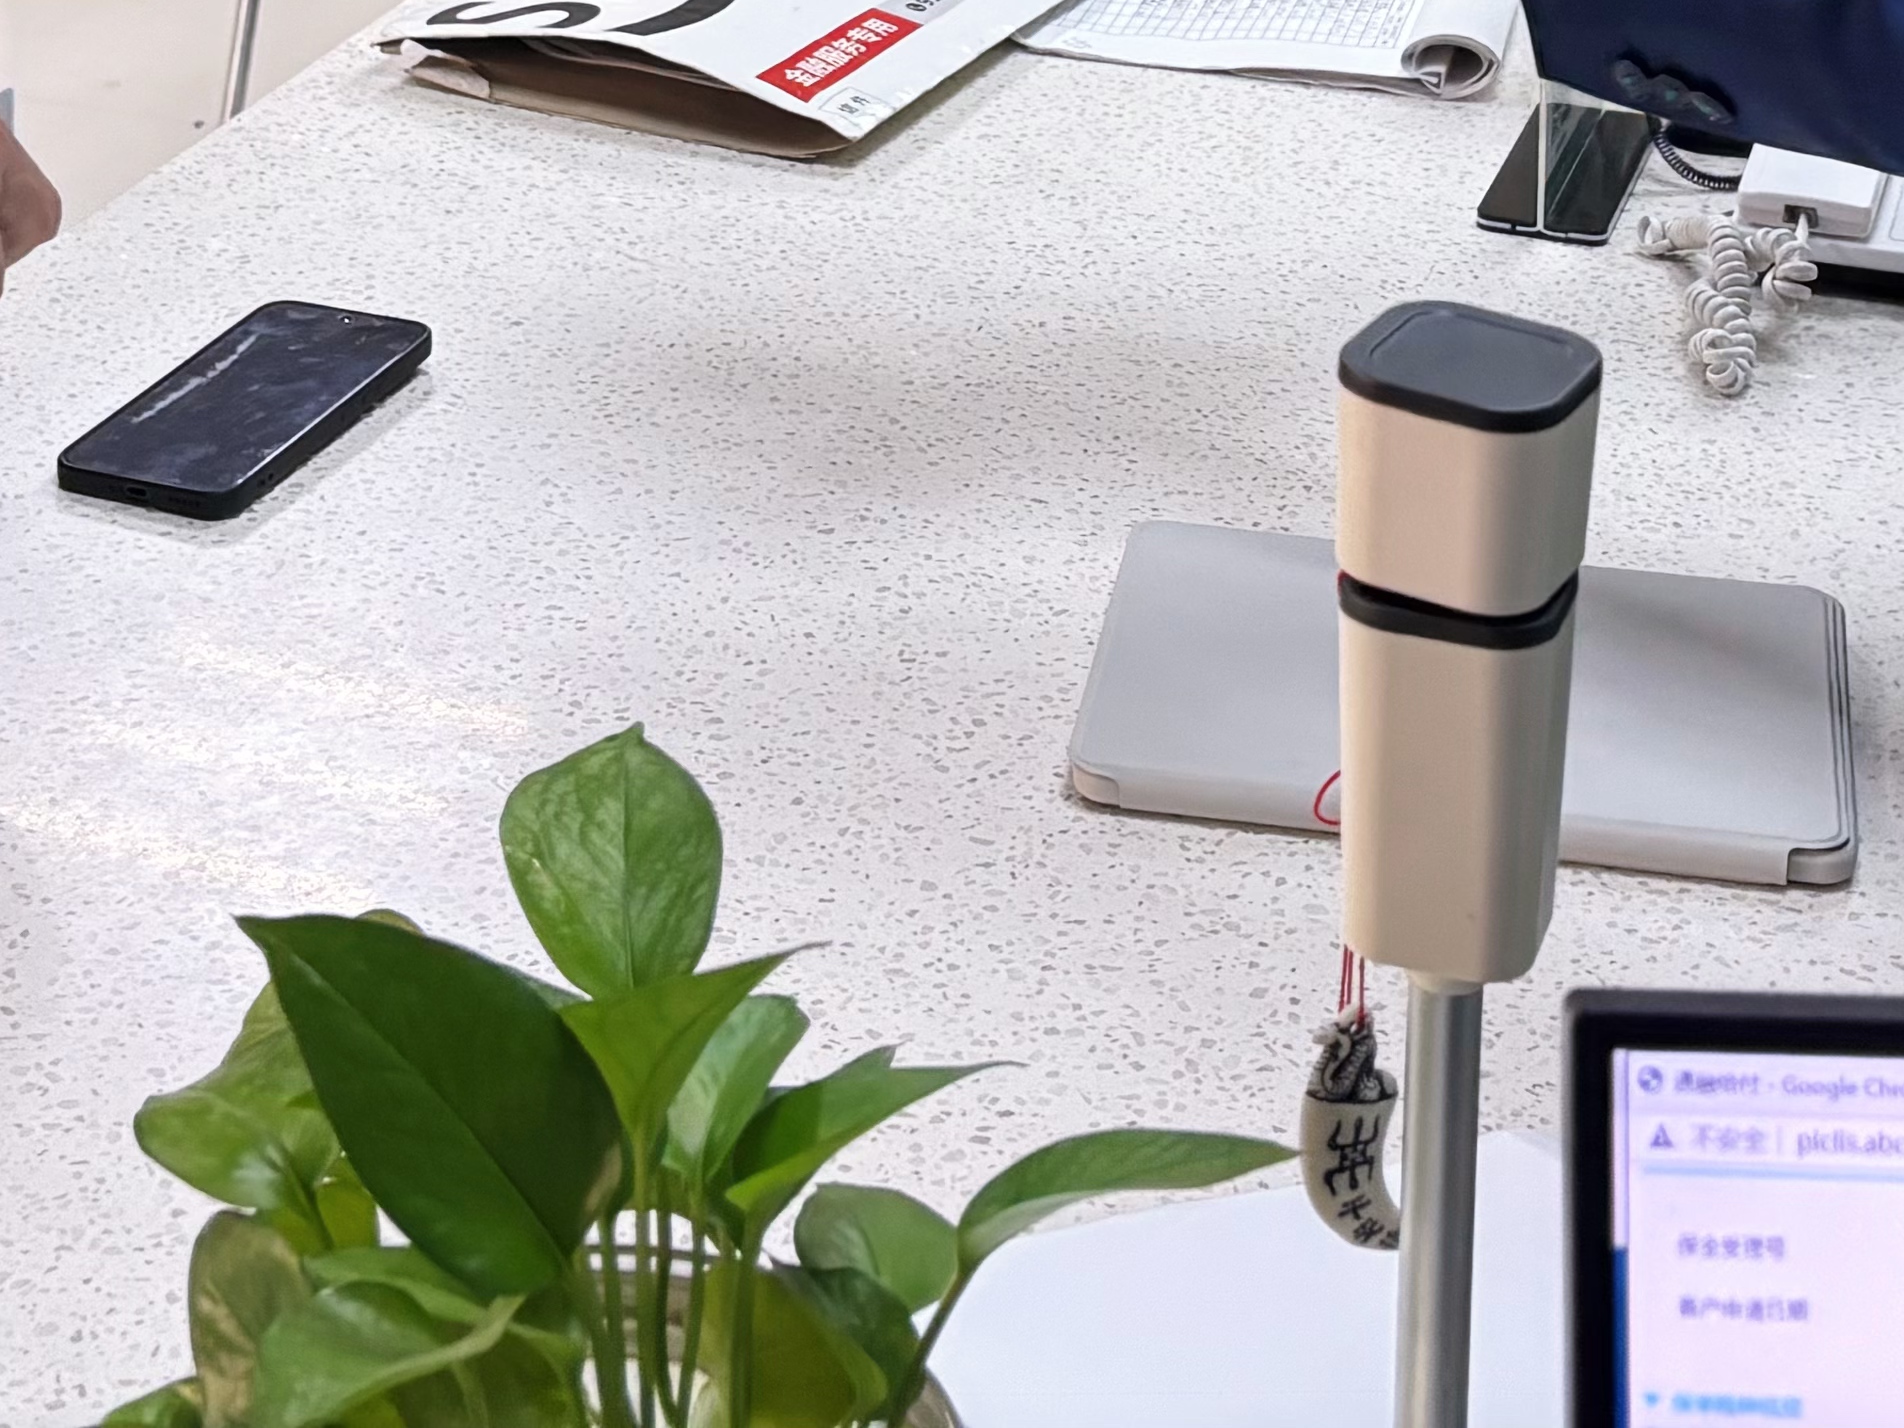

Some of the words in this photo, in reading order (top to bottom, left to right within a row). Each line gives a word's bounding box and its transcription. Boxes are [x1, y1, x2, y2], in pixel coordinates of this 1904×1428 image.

[784, 17, 899, 87] 金融服务专用
[1781, 1074, 1858, 1101] Google
